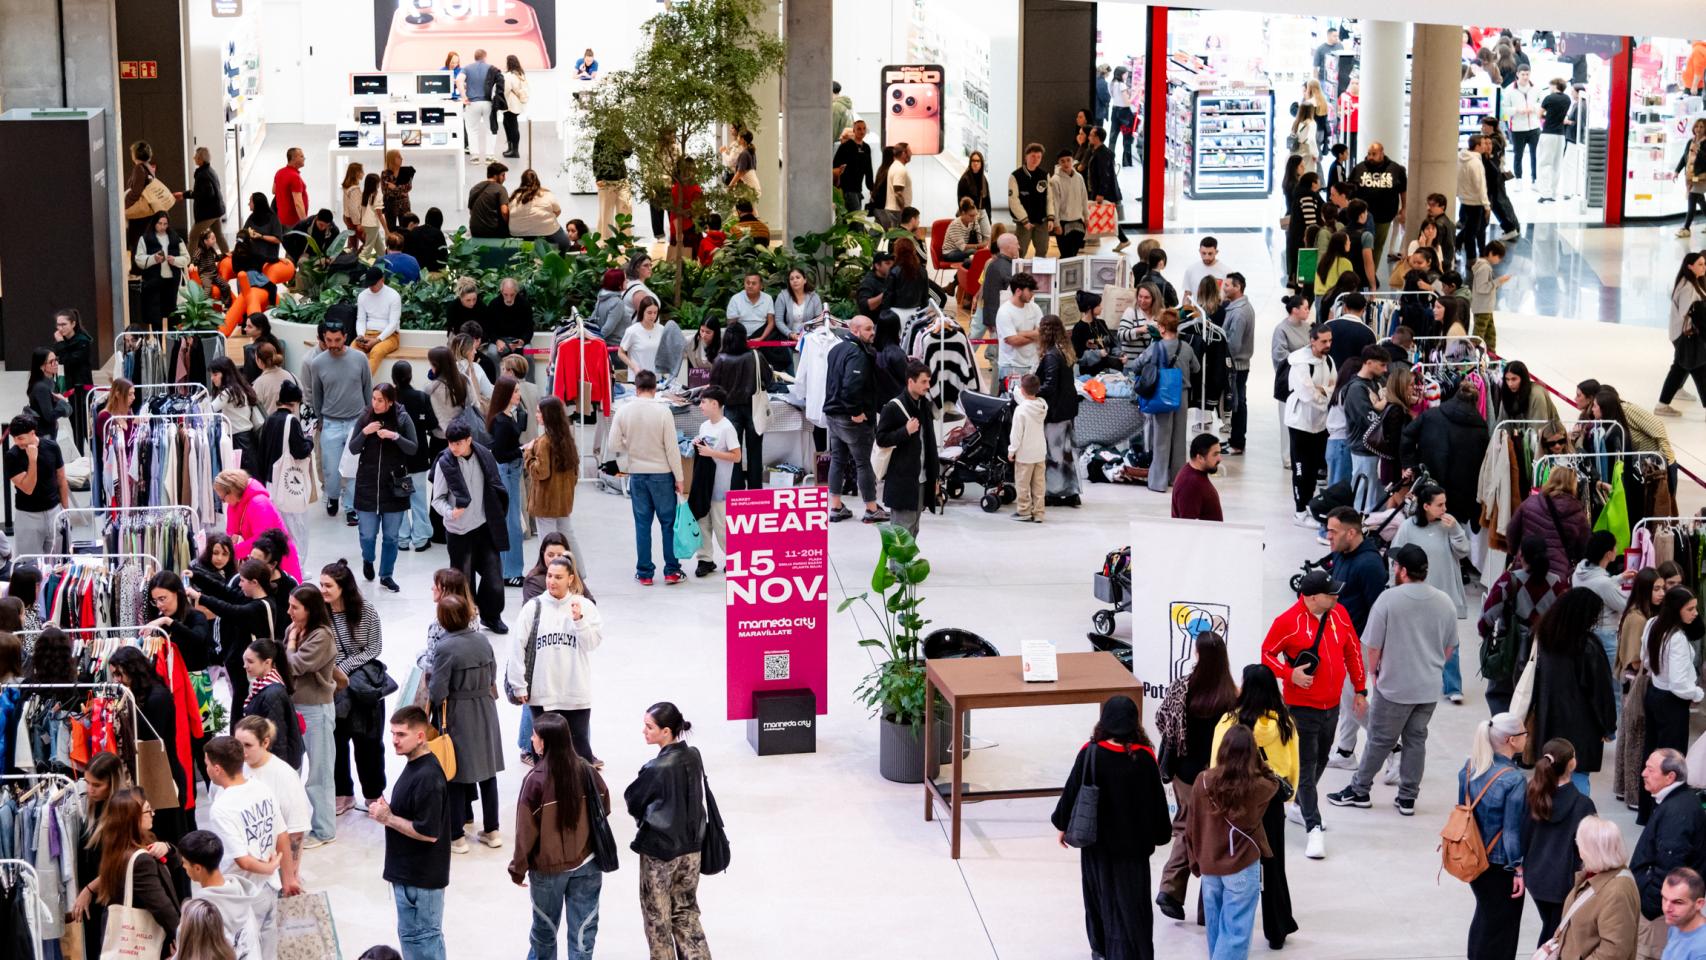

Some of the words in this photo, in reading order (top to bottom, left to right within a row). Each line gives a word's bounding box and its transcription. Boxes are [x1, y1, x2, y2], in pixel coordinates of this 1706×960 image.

[886, 71, 940, 83] PRO
[1360, 179, 1393, 188] JONES
[773, 488, 828, 510] RE:
[725, 511, 828, 535] WEAR
[785, 549, 822, 558] 11-20H
[726, 549, 776, 577] 15
[726, 575, 827, 606] NOV.
[738, 618, 792, 630] marineda
[794, 617, 816, 630] city
[738, 629, 792, 638] MARAVÍLLATE
[537, 632, 577, 650] BROOKLYN
[763, 720, 796, 728] marineda
[797, 719, 811, 728] city
